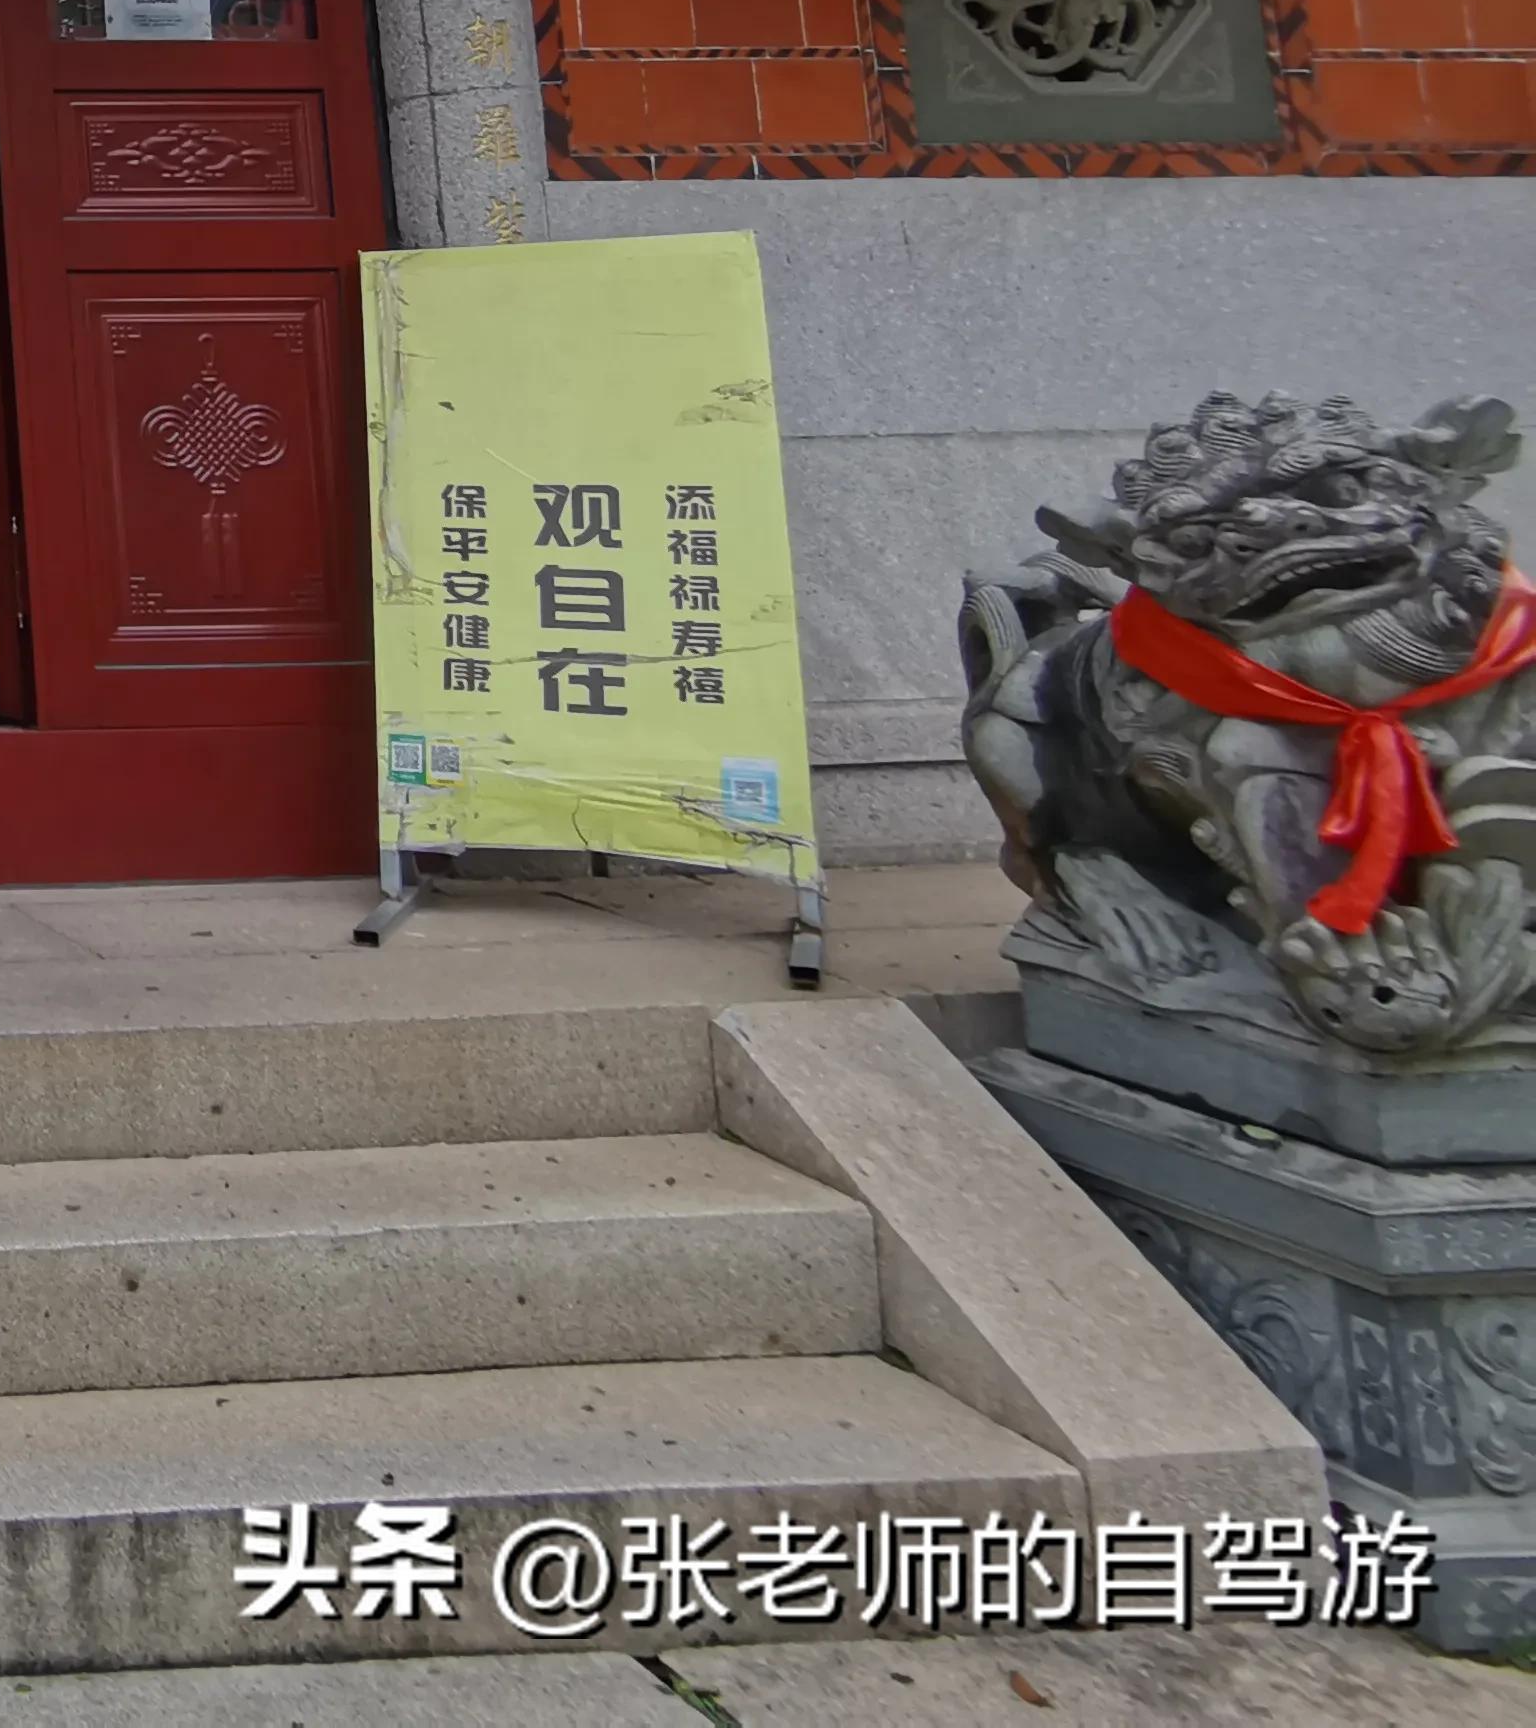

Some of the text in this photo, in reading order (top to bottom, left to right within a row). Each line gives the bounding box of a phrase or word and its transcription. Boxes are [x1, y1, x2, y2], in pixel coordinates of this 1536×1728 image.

[440, 483, 492, 695] 保平安健康
[532, 483, 629, 717] 观自在
[664, 483, 726, 705] 添福禄寿禧
